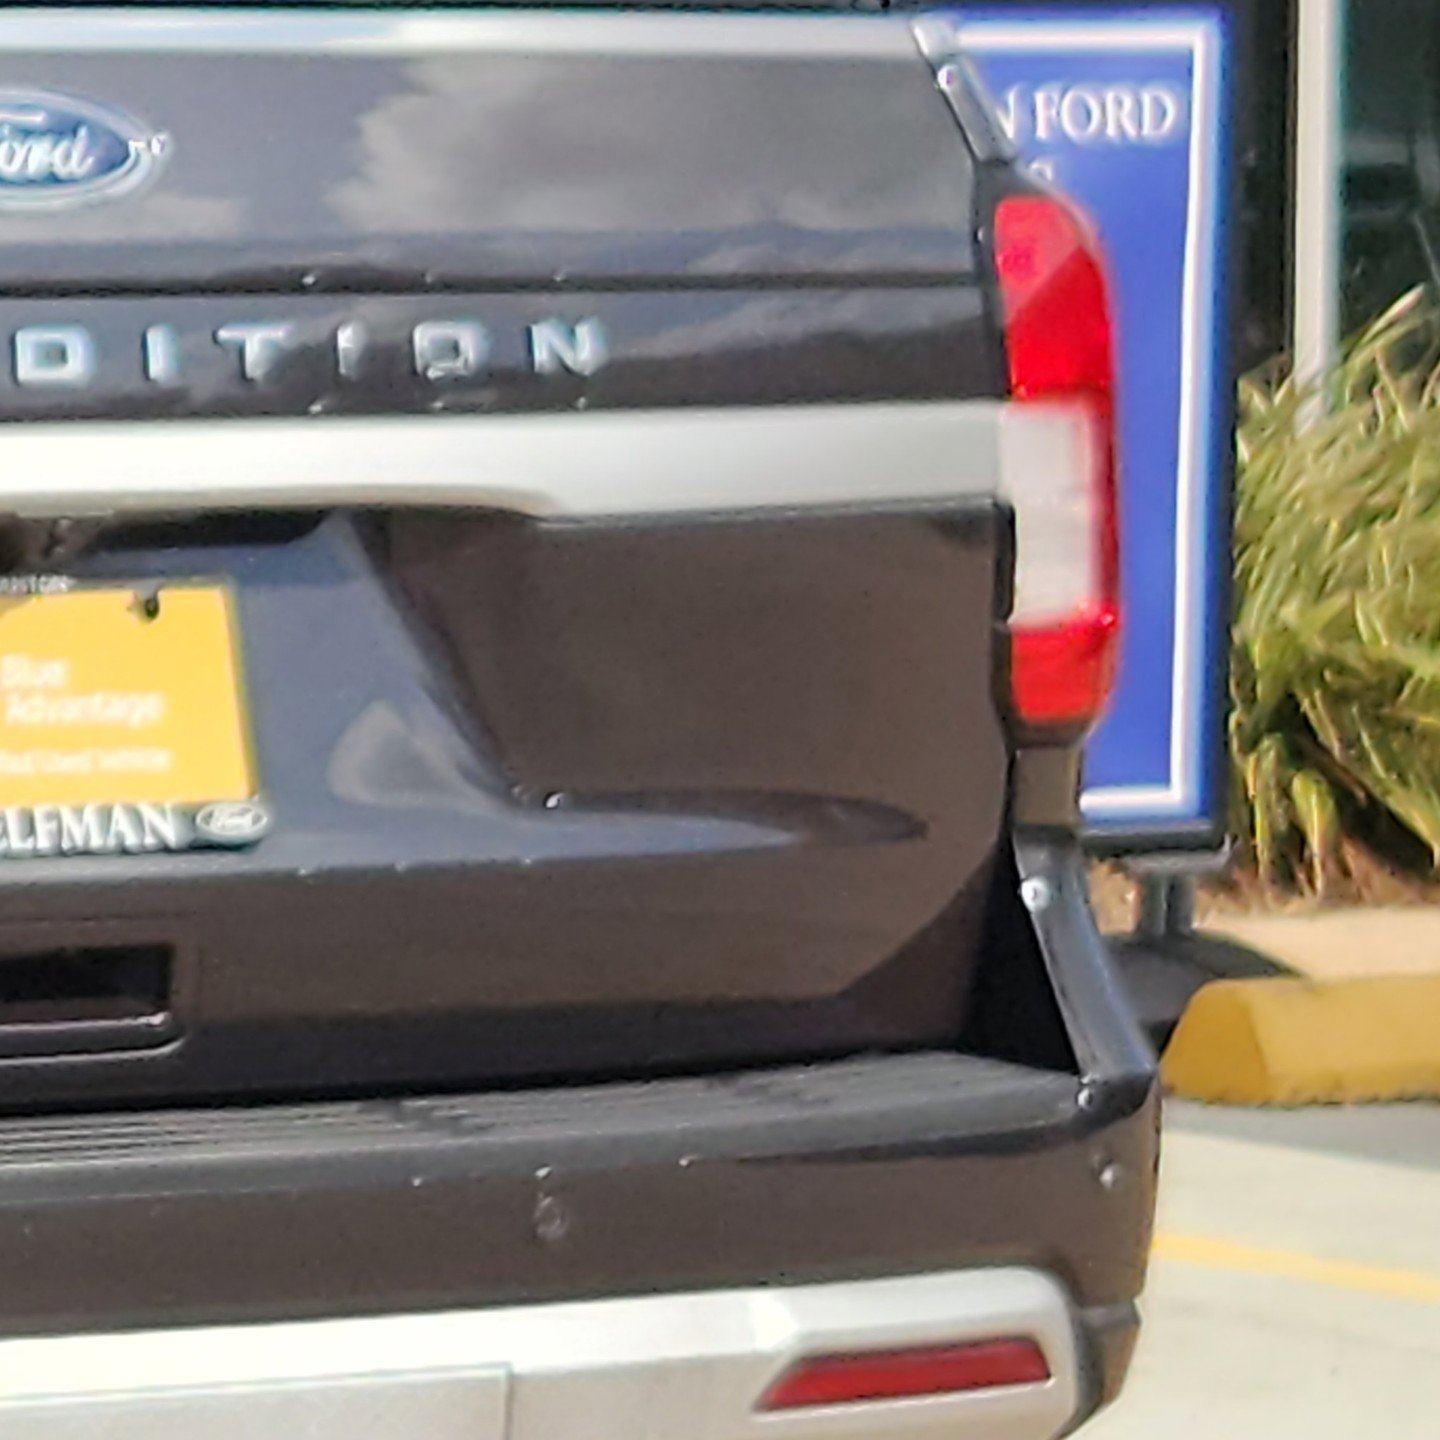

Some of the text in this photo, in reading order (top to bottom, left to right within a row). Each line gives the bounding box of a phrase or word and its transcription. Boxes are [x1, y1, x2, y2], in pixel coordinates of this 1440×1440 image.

[1034, 89, 1176, 140] FORD
[1, 654, 70, 688] Blue
[5, 690, 166, 728] Advantage
